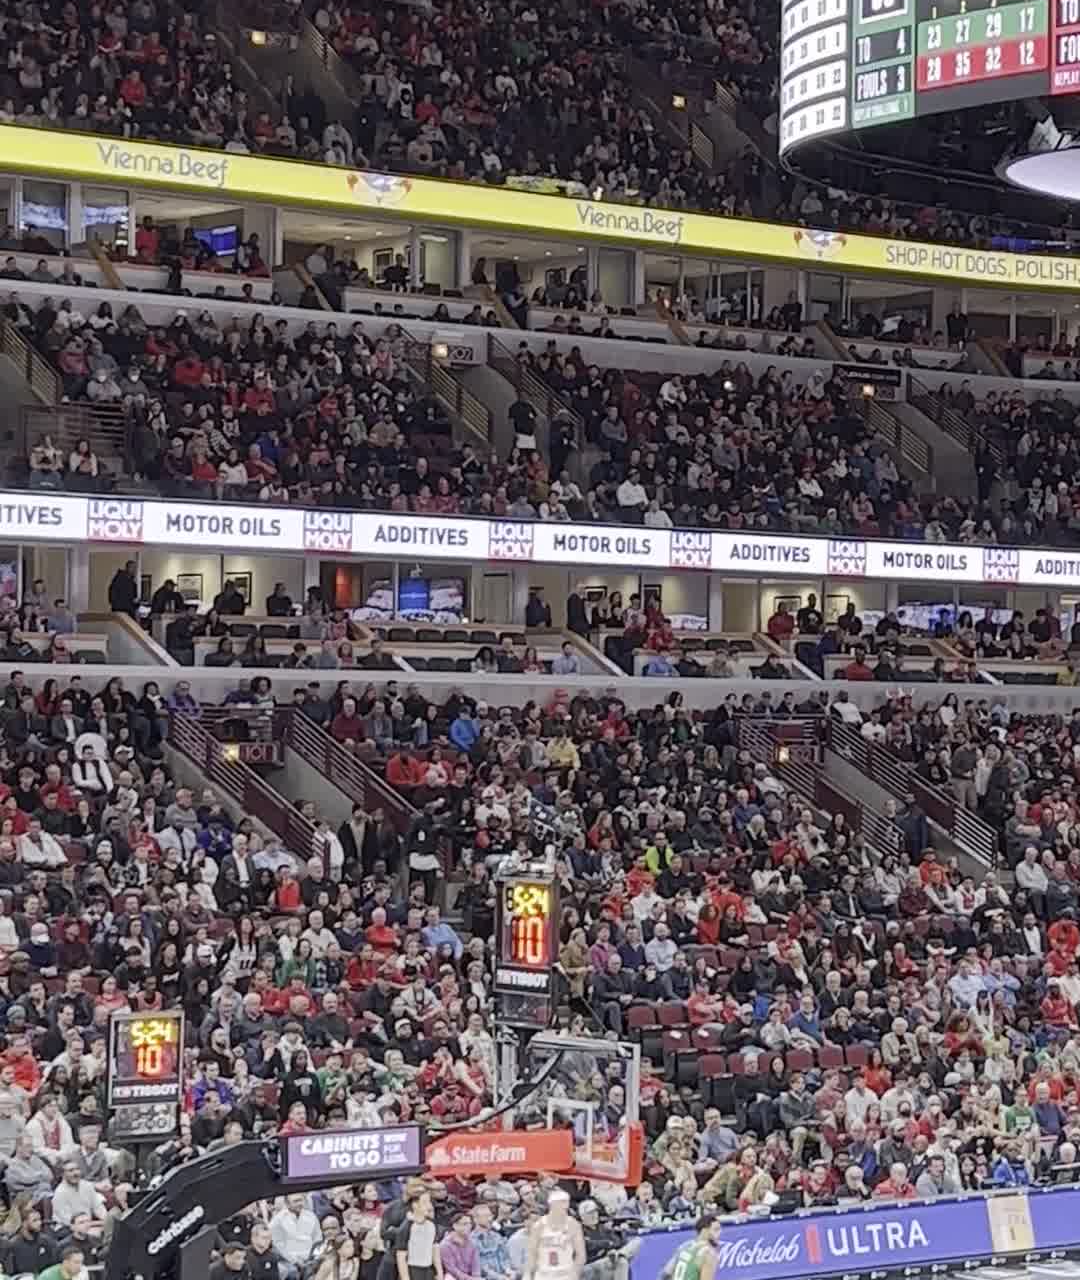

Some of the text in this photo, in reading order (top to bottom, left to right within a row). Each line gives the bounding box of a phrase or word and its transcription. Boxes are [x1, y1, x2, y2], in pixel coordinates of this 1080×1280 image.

[926, 6, 1035, 49] 23 27 29 17
[857, 28, 905, 63] TO 4
[955, 39, 1035, 76] 35 32 12
[857, 69, 906, 102] FOULS 3
[97, 141, 228, 188] Vienna Beef
[576, 203, 684, 243] Vienna Beef
[886, 246, 928, 266] SHOP
[931, 251, 962, 271] HOT
[965, 256, 1012, 278] DOGS,
[88, 498, 144, 520] LIQUI
[304, 510, 352, 530] LIQUI
[88, 521, 144, 538] MOLY
[166, 513, 281, 537] MOTOR OILS
[374, 525, 469, 546] ADDITIVES
[304, 531, 352, 550] MOLY
[553, 534, 651, 555] MOTOR OILS
[828, 540, 867, 557] LIQUI
[730, 543, 810, 563] ADDITIVES
[883, 551, 968, 571] MOTOR OILS
[828, 558, 867, 574] MOLY
[512, 917, 544, 964] 10
[137, 1046, 162, 1075] 10
[131, 1084, 178, 1098] TISSOT
[301, 1133, 380, 1156] CABINETS
[329, 1151, 351, 1169] TO
[354, 1151, 380, 1167] GO
[148, 1205, 204, 1255] coinbase
[718, 1219, 929, 1268] Michelob ULTRA
